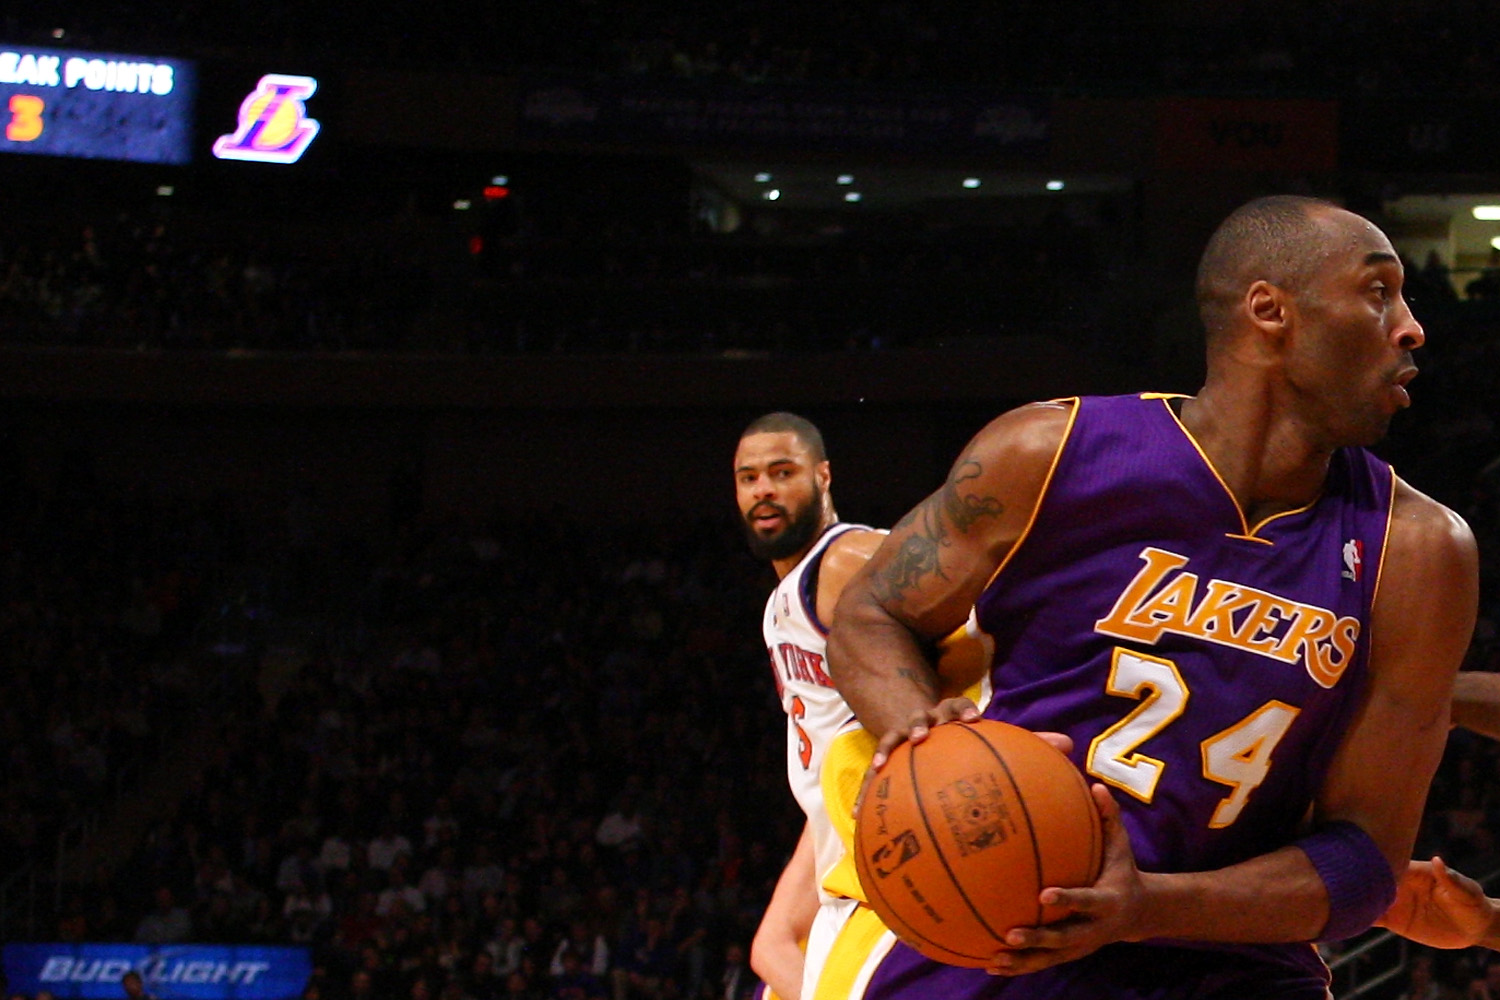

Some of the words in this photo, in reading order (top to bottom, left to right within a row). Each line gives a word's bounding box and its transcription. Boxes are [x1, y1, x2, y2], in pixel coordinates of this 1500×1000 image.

[65, 57, 174, 96] POINTS
[6, 94, 45, 142] 3
[1093, 545, 1360, 689] LAKERS
[1085, 645, 1302, 829] 24
[37, 954, 132, 983] BUD
[135, 950, 270, 985] LIGHT
